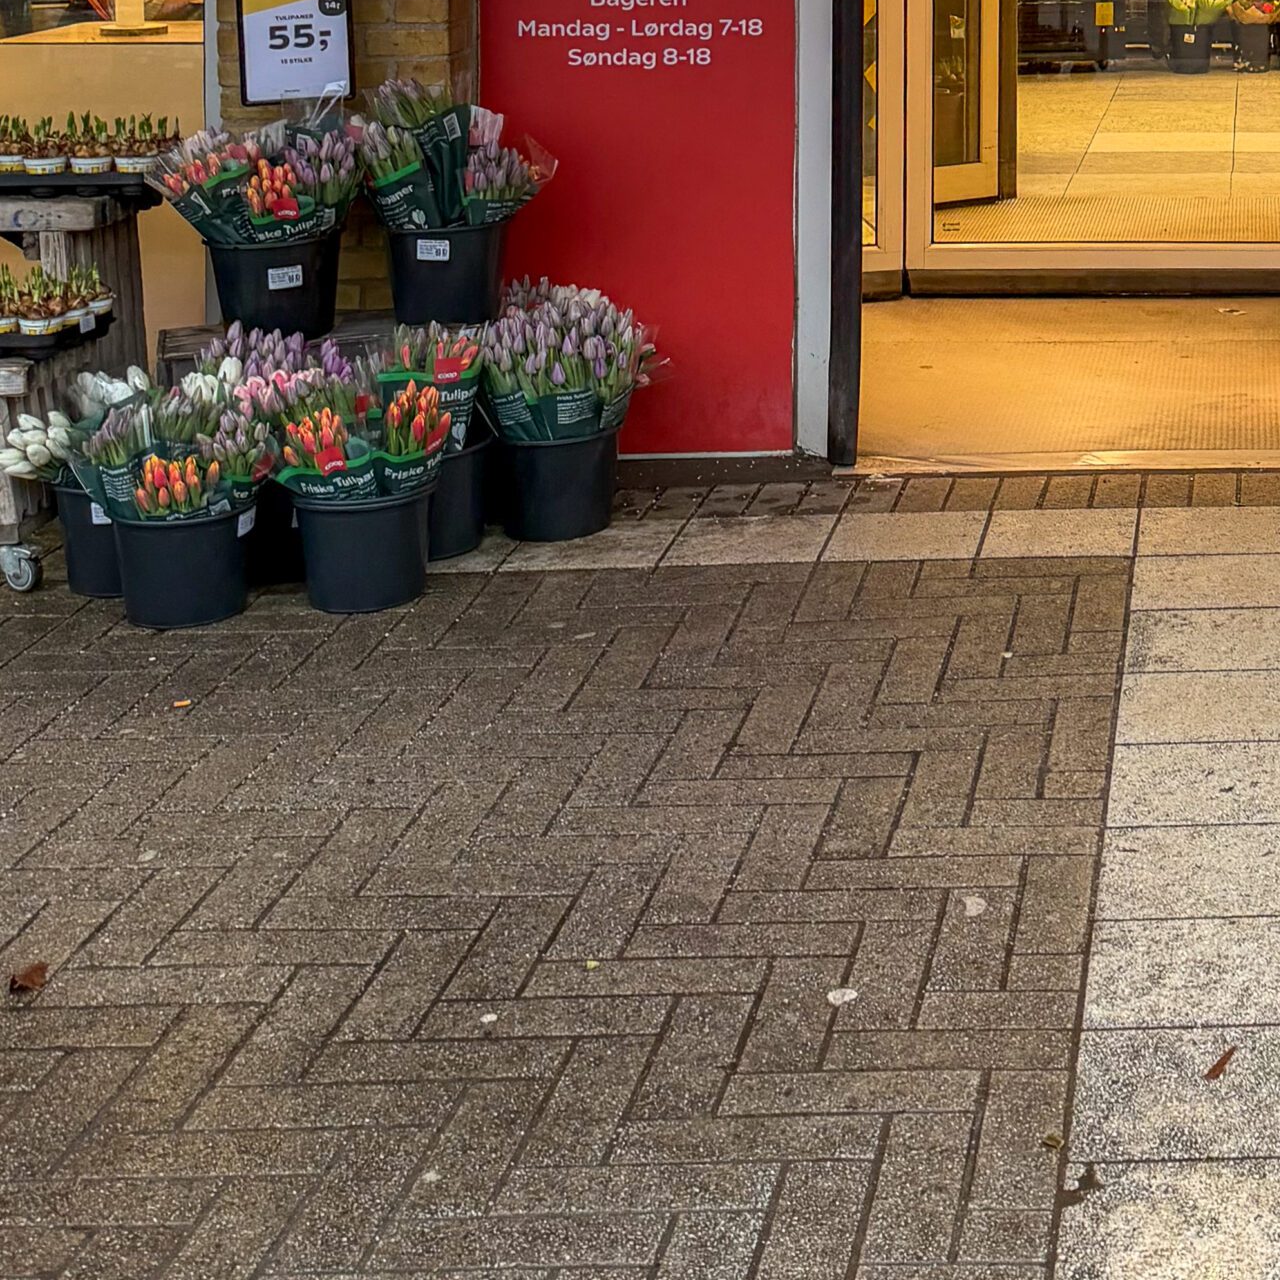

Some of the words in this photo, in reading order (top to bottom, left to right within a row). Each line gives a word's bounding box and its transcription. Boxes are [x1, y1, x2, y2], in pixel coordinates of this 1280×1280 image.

[517, 19, 611, 41] Mandag
[631, 19, 713, 41] Lørdag
[719, 19, 763, 36] 7-18
[567, 48, 657, 70] Søndag
[663, 47, 711, 65] 8-18
